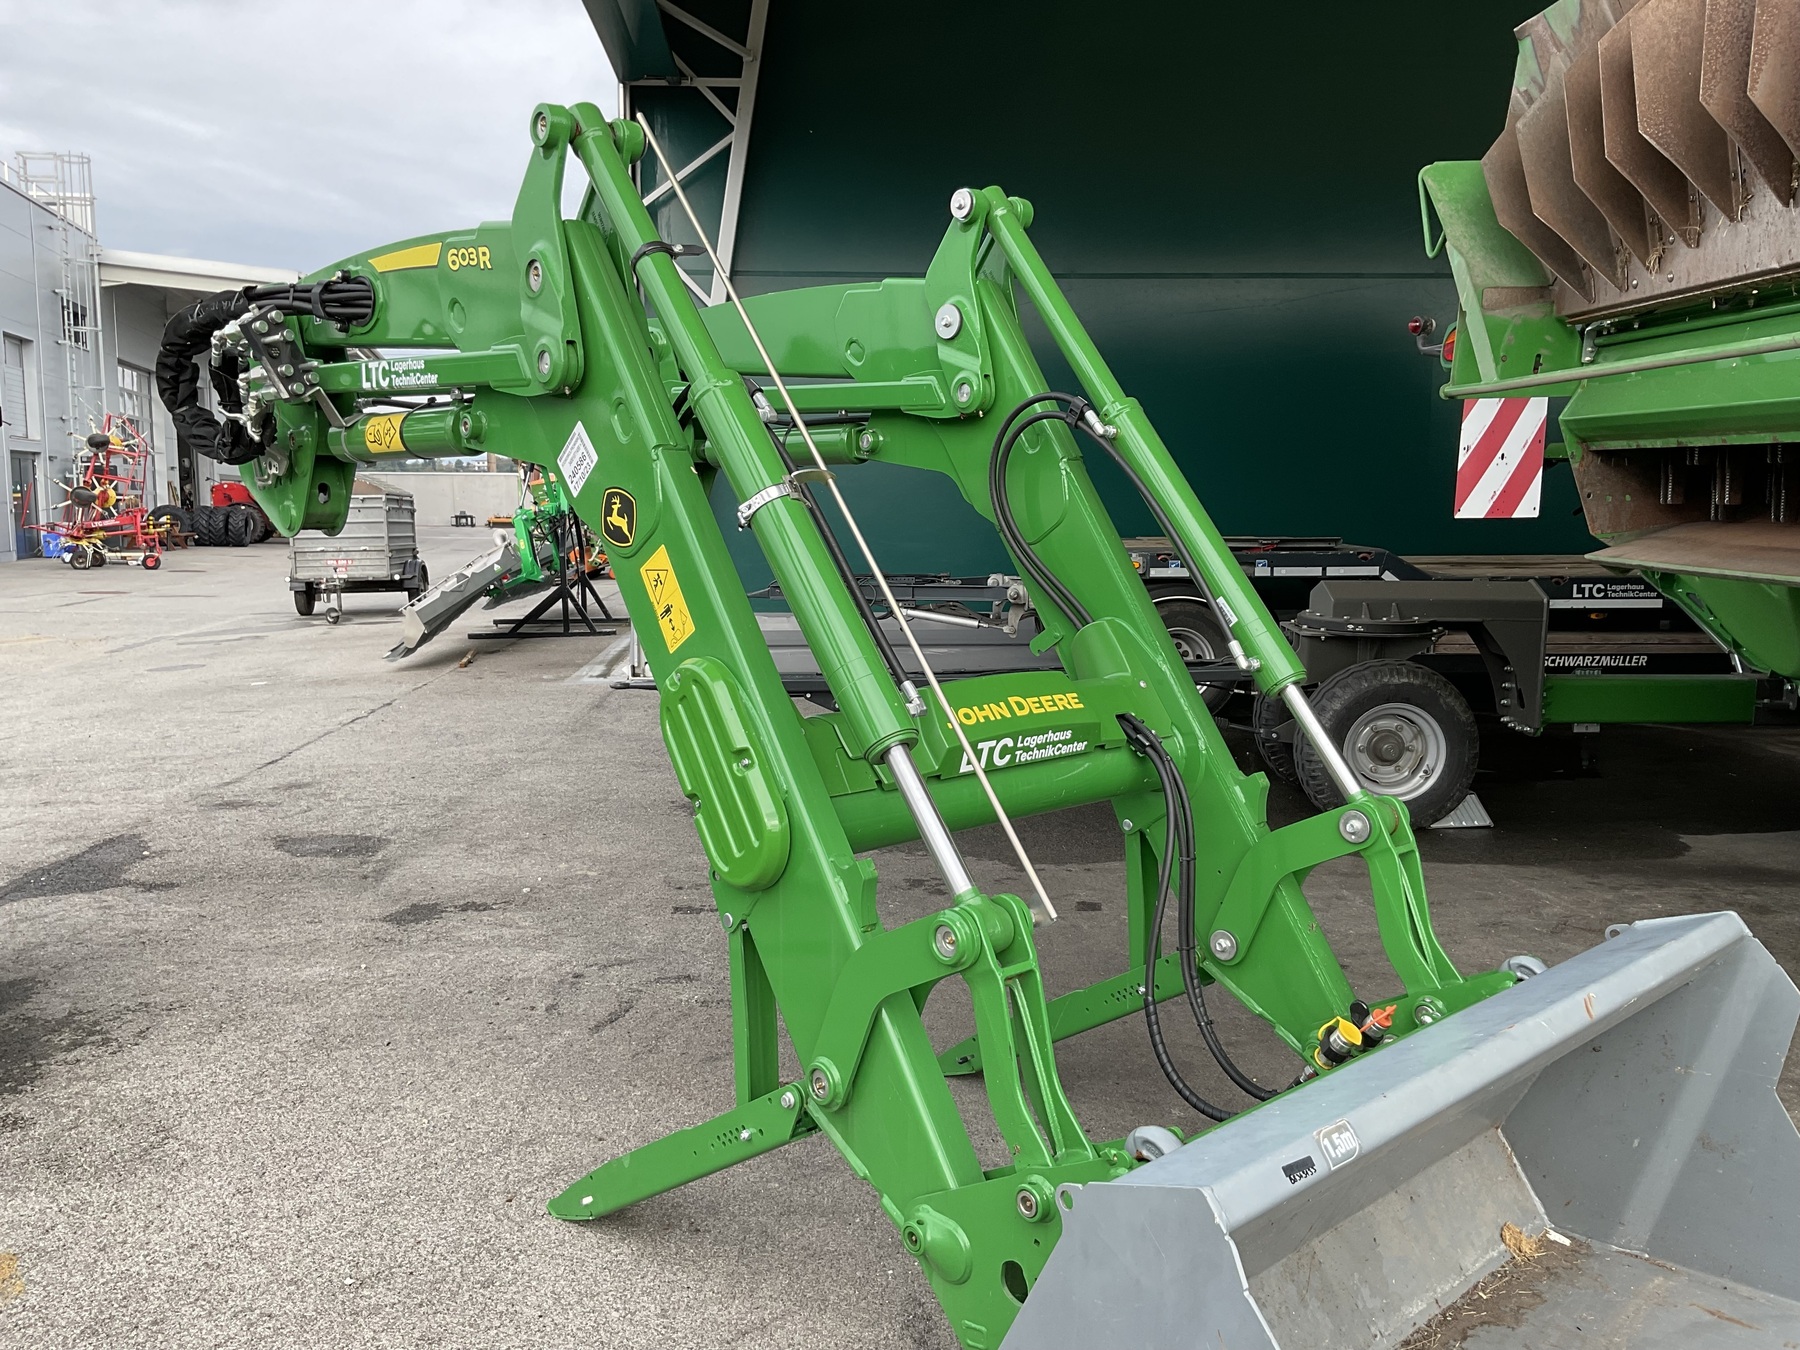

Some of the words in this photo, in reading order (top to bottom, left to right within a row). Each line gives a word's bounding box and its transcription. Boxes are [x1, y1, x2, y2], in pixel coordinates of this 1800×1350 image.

[447, 246, 493, 271] 603R
[361, 361, 390, 389] LTC
[390, 359, 425, 373] Lagerhaus
[391, 373, 439, 387] TechnikCenter
[568, 451, 587, 484] 240586
[1572, 584, 1605, 598] LTC
[1008, 693, 1084, 716] DEERE
[1017, 729, 1073, 748] Lagerhaus
[1015, 740, 1088, 763] TechnikCenter
[1323, 1131, 1356, 1158] 1,5m
